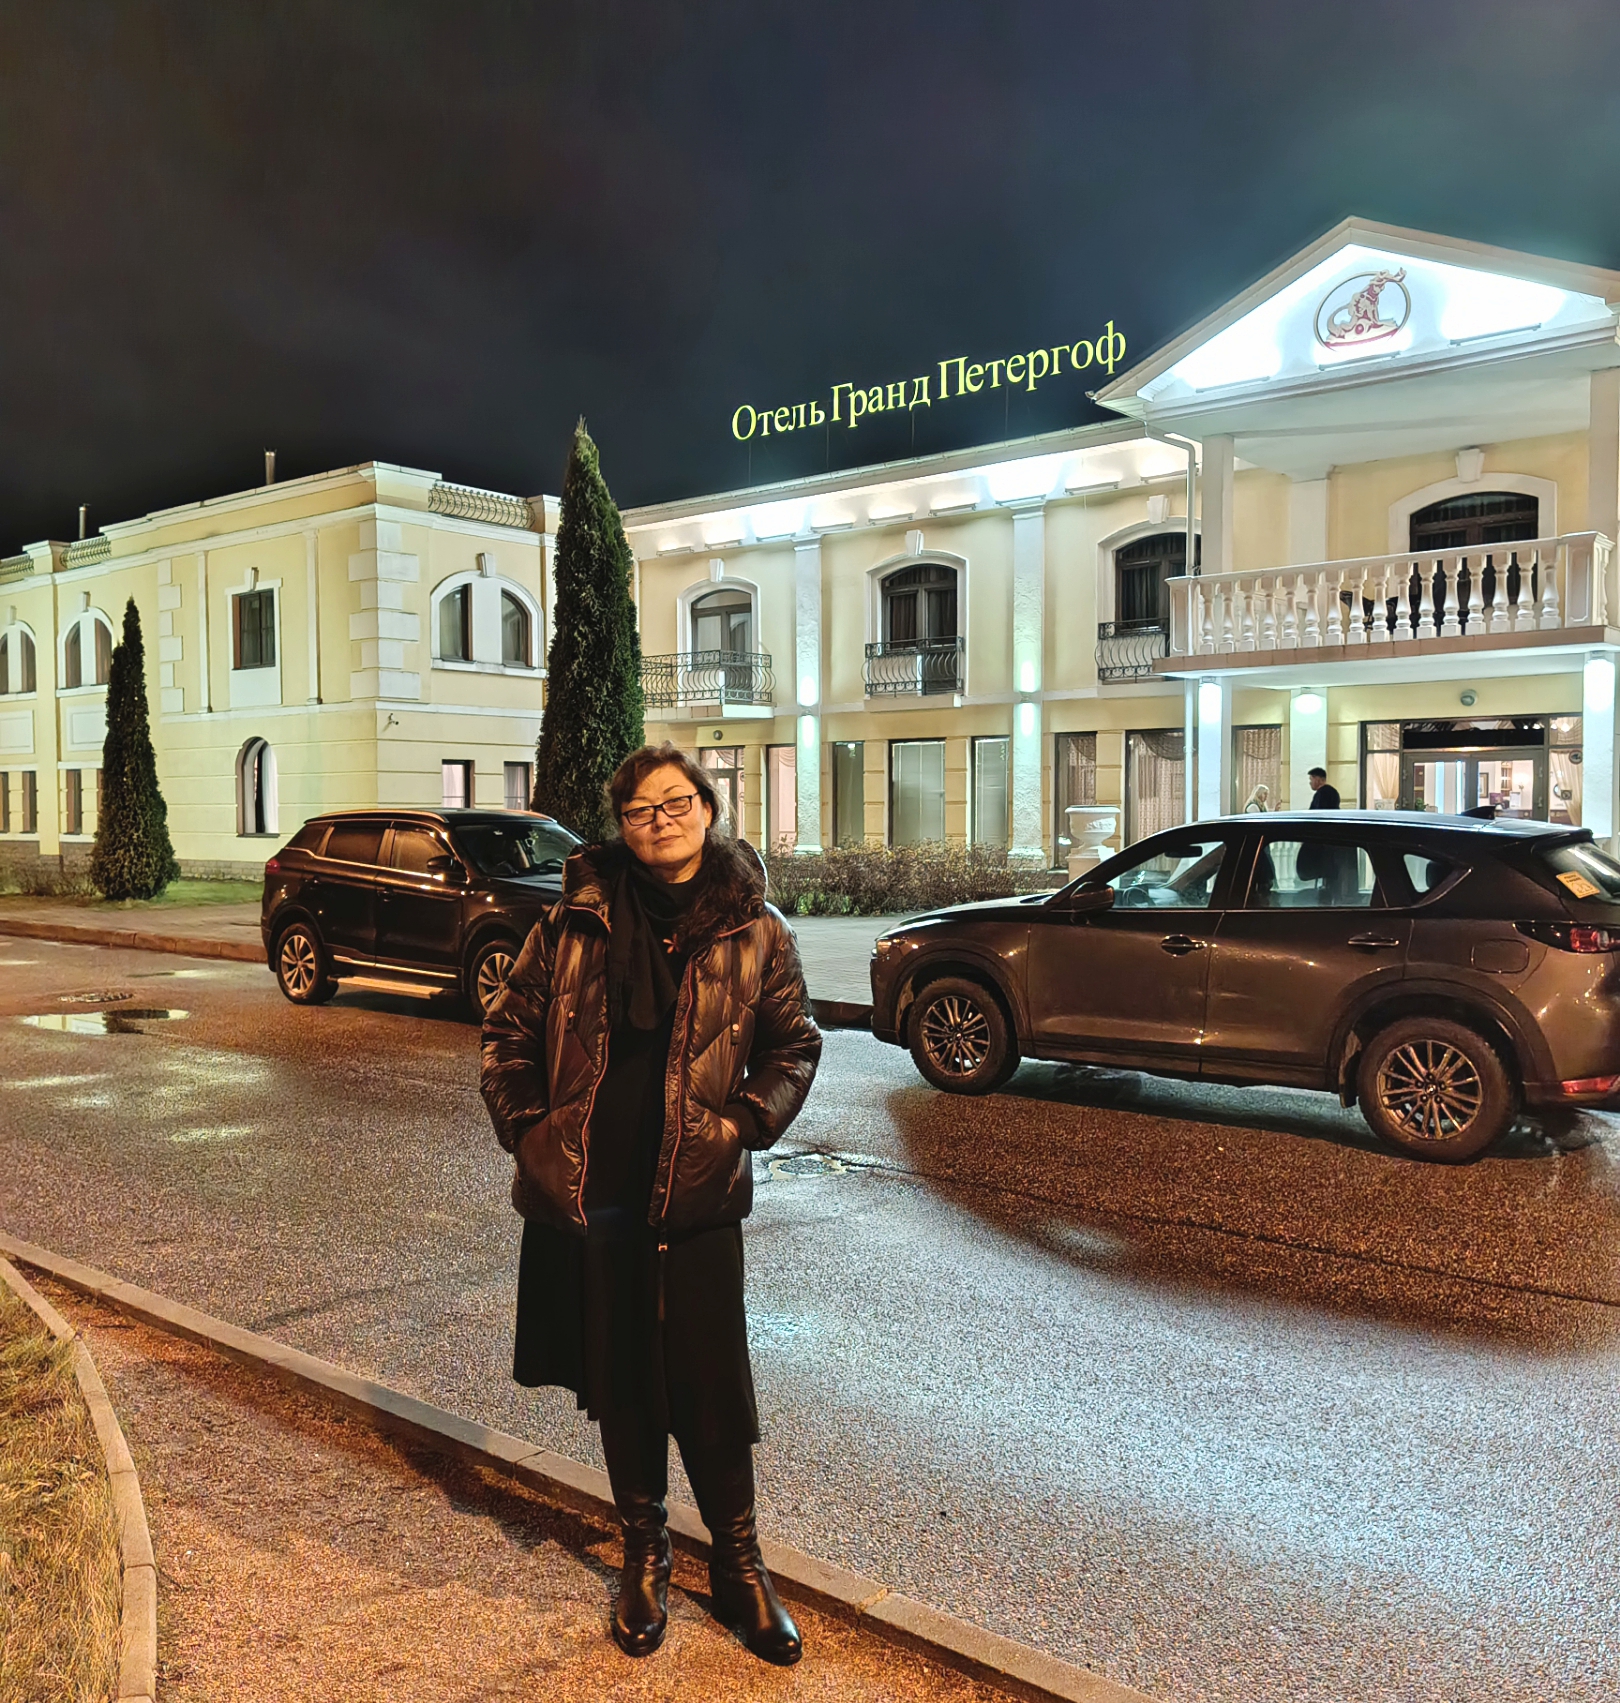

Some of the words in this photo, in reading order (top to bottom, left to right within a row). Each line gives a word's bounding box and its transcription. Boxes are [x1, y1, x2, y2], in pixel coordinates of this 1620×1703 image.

[731, 401, 825, 441] Отель
[831, 375, 931, 428] Гранд
[938, 319, 1127, 400] Петергоф
